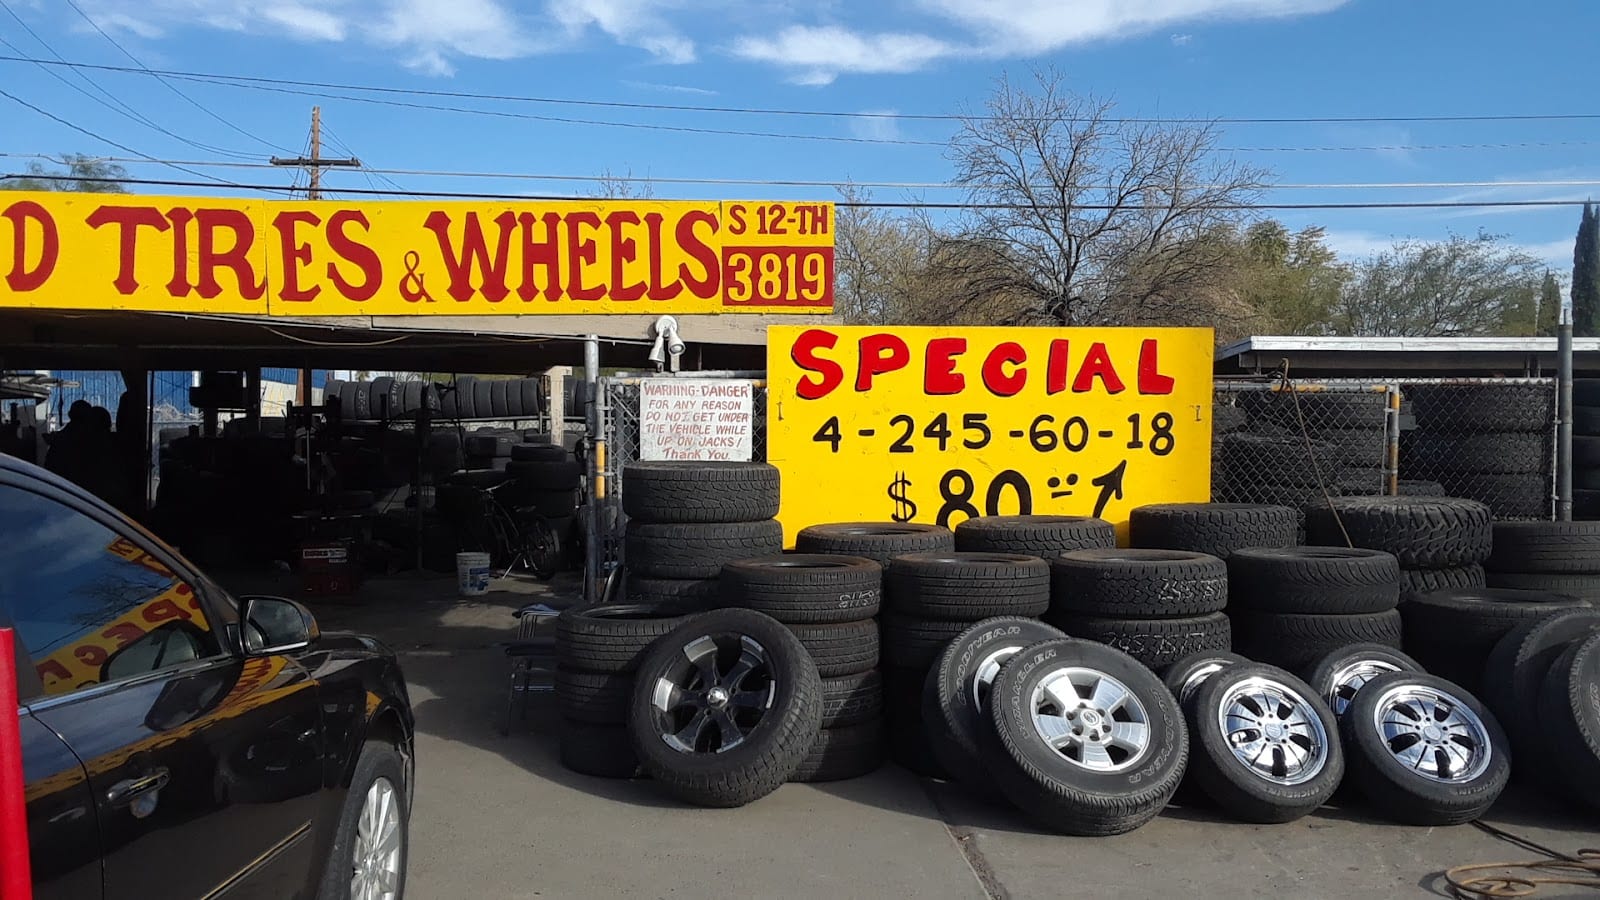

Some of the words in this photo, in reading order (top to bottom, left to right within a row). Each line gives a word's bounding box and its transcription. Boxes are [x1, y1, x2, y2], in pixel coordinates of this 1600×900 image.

[728, 204, 747, 235] S
[756, 204, 829, 236] 12-TH
[2, 201, 59, 292] D
[85, 205, 383, 302] TIRES
[399, 250, 436, 303] &
[423, 210, 721, 303] WHEELS
[728, 253, 826, 302] 3819
[790, 329, 1176, 400] SPECIAL
[648, 399, 669, 410] FOR
[673, 400, 697, 410] ANY
[701, 401, 742, 411] REASON
[645, 411, 661, 421] DO
[692, 412, 715, 422] GET
[718, 412, 749, 423] UNDER
[645, 423, 665, 434] THE
[669, 423, 711, 435] VEHICLE
[716, 425, 748, 436] WHILE
[656, 436, 672, 446] UP
[677, 436, 693, 446] ON
[662, 447, 701, 460] Thank
